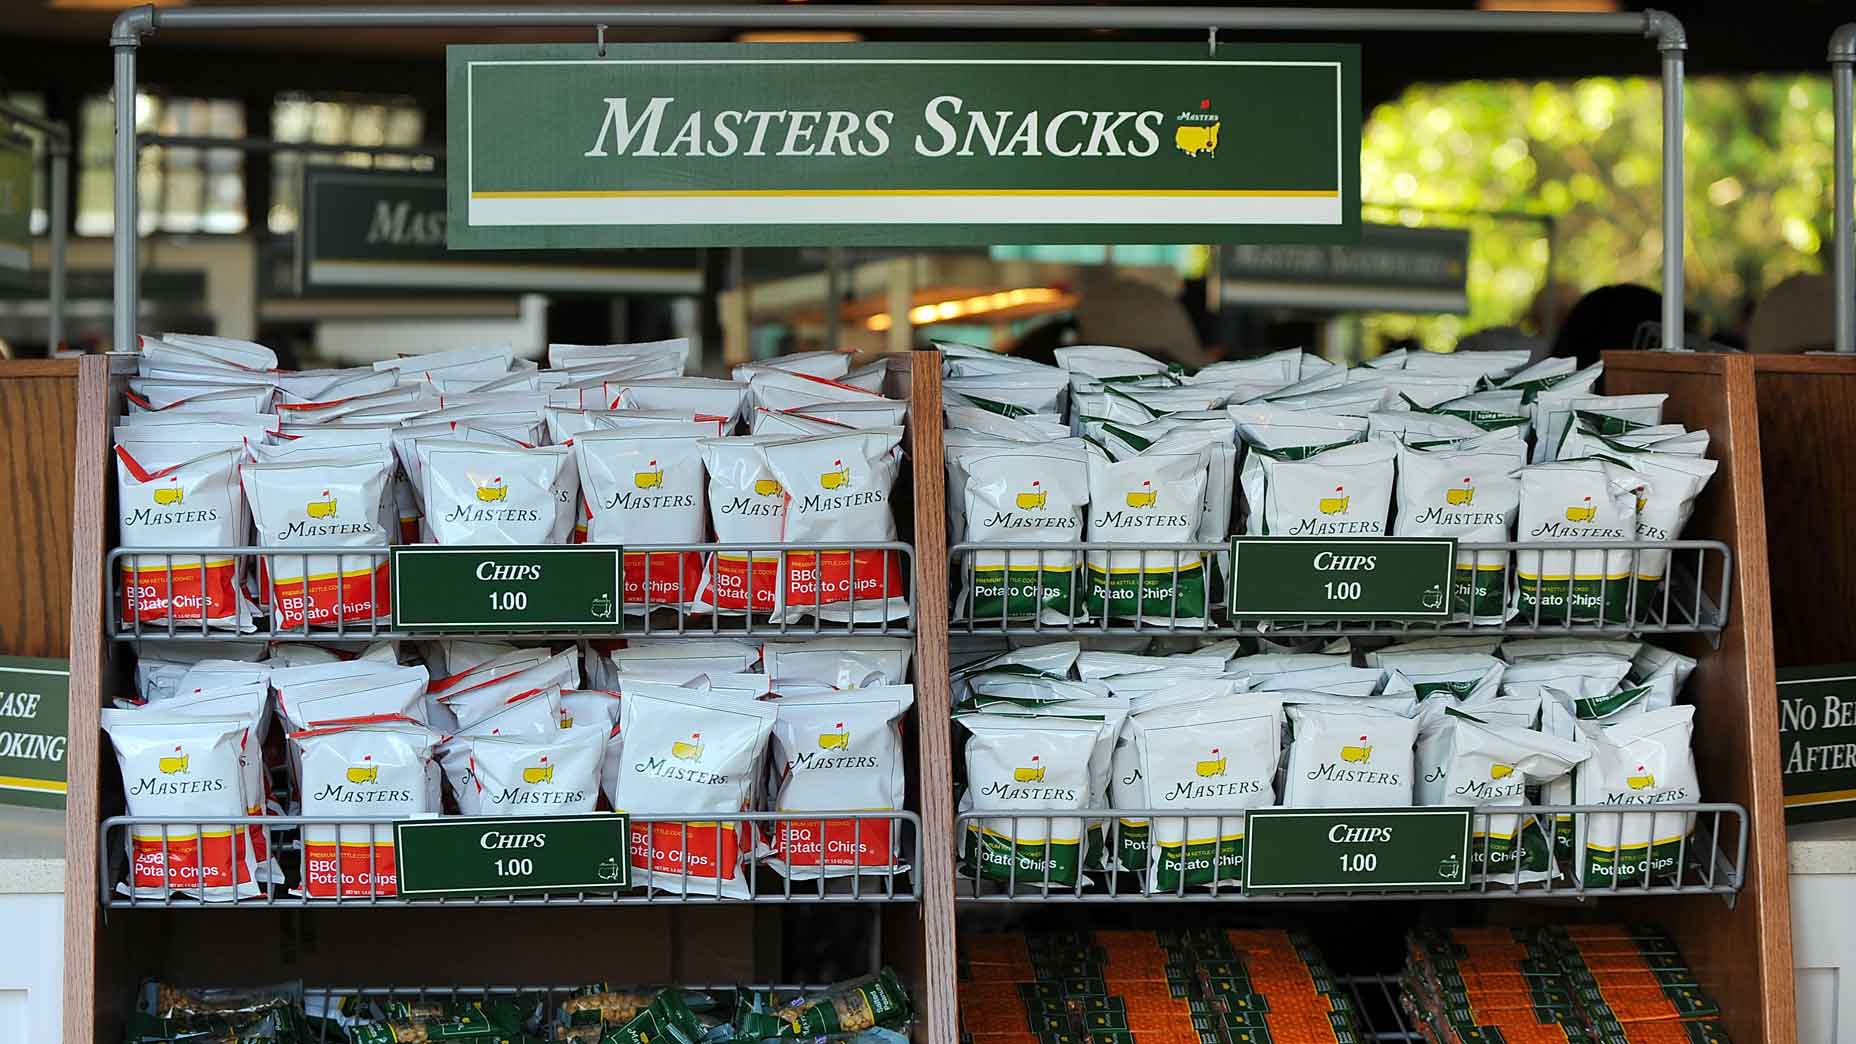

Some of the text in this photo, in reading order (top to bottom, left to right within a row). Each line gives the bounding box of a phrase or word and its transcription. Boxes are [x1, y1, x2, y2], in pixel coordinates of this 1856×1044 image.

[584, 95, 1164, 157] MASTERS SNACKS
[367, 200, 447, 243] MAS
[721, 497, 784, 518] MAST
[1313, 551, 1377, 572] CHIPS
[475, 561, 540, 582] CHIPS
[127, 586, 156, 598] BBQ
[791, 581, 836, 593] Potto
[975, 586, 1061, 598] Potao Chps
[1323, 582, 1361, 601] 1.00
[488, 591, 527, 612] 1.00
[1522, 592, 1563, 606] Poato
[285, 601, 372, 621] Poato Chips
[0, 692, 41, 719] ASE
[0, 731, 67, 762] OKING
[479, 831, 546, 851] CHIPS
[1328, 824, 1393, 845] CHIPS
[1124, 839, 1151, 850] Pot
[630, 845, 708, 865] otato Cips
[1165, 859, 1210, 872] Poato
[1213, 854, 1243, 867] Chip
[1339, 854, 1377, 873] 1.00
[1490, 847, 1527, 863] Chps
[135, 863, 219, 880] Potao Chps
[494, 859, 533, 878] 1.00
[358, 873, 397, 887] Cips
